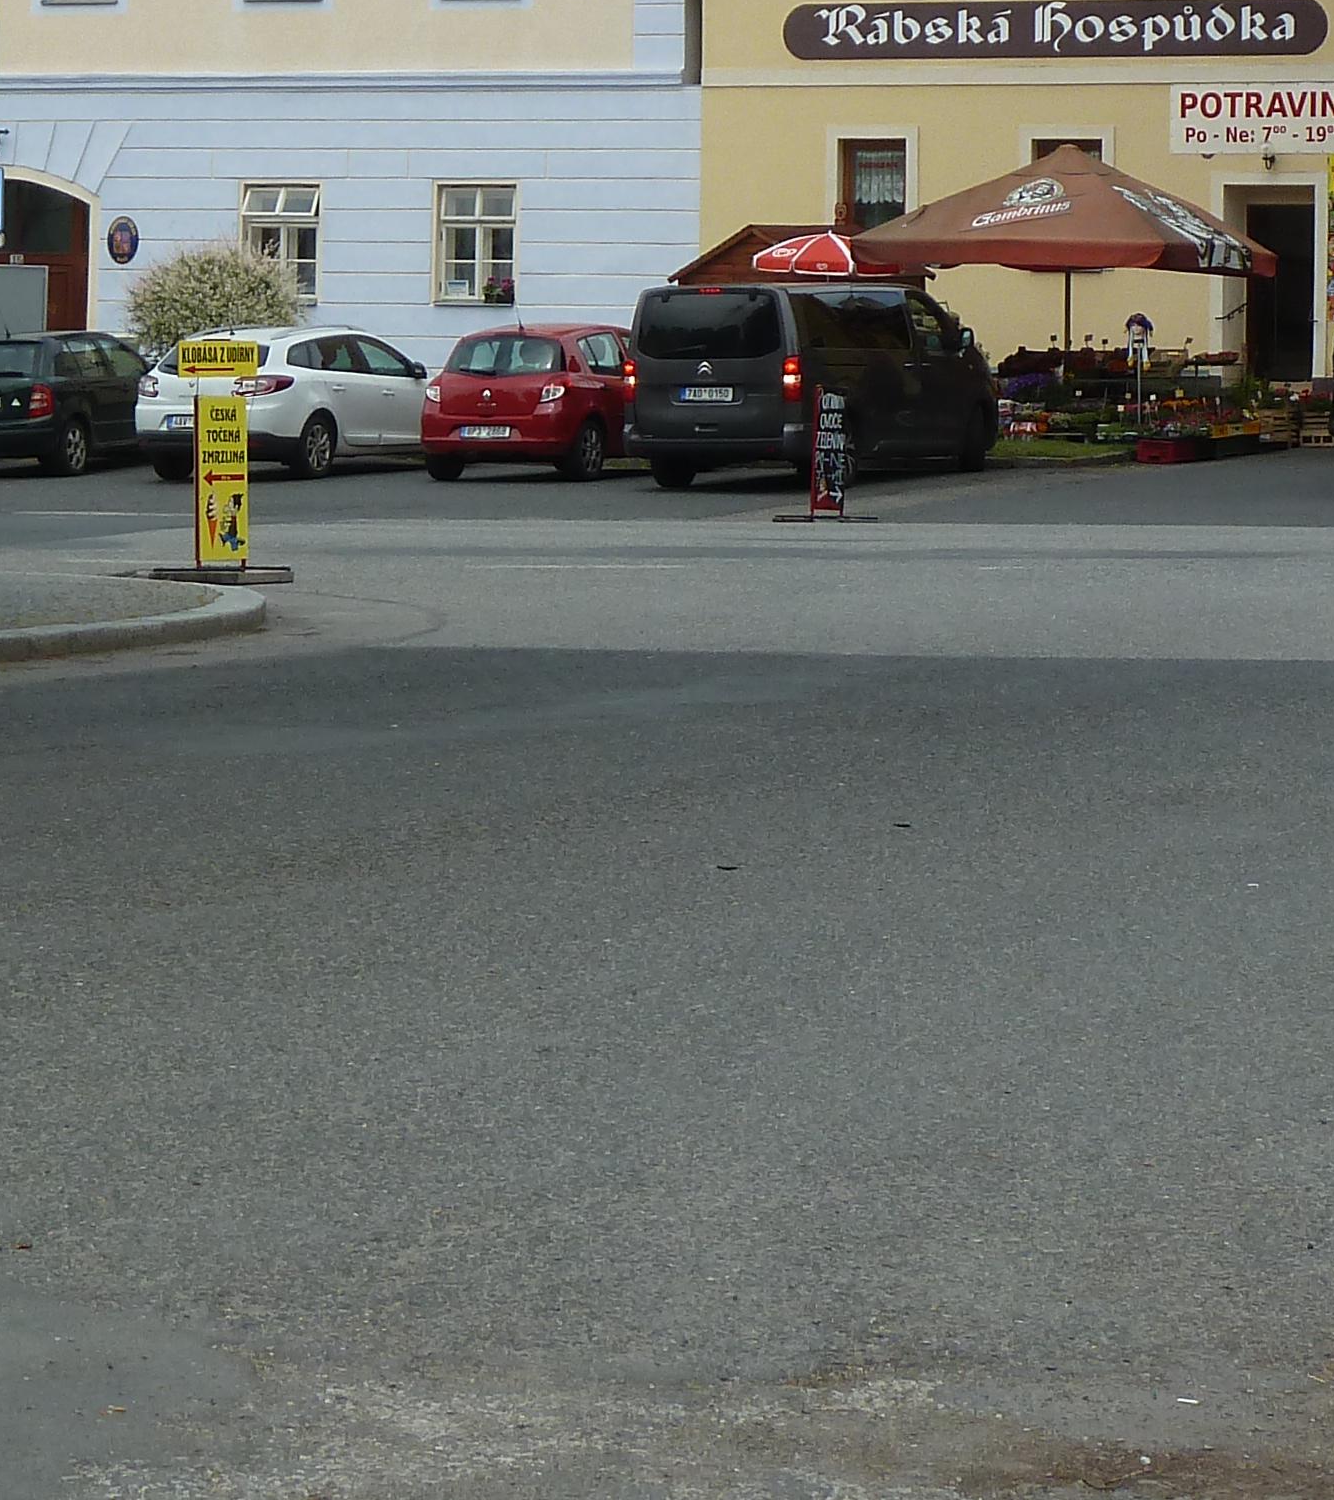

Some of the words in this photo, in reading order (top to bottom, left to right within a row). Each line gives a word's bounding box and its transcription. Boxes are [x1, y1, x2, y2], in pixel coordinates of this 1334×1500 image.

[814, 3, 1012, 46] Rábská
[1034, 1, 1296, 52] Hospůdka
[1185, 127, 1207, 143] Po
[1226, 126, 1255, 143] Ne:
[972, 201, 1072, 227] Gambrinus
[181, 344, 218, 364] KLOBÁSA
[220, 347, 225, 363] Z
[227, 344, 255, 363] UDÍRNY
[210, 405, 237, 422] ČESKÁ
[206, 426, 240, 443] TOČENÁ
[202, 450, 245, 464] ZMRZLINA
